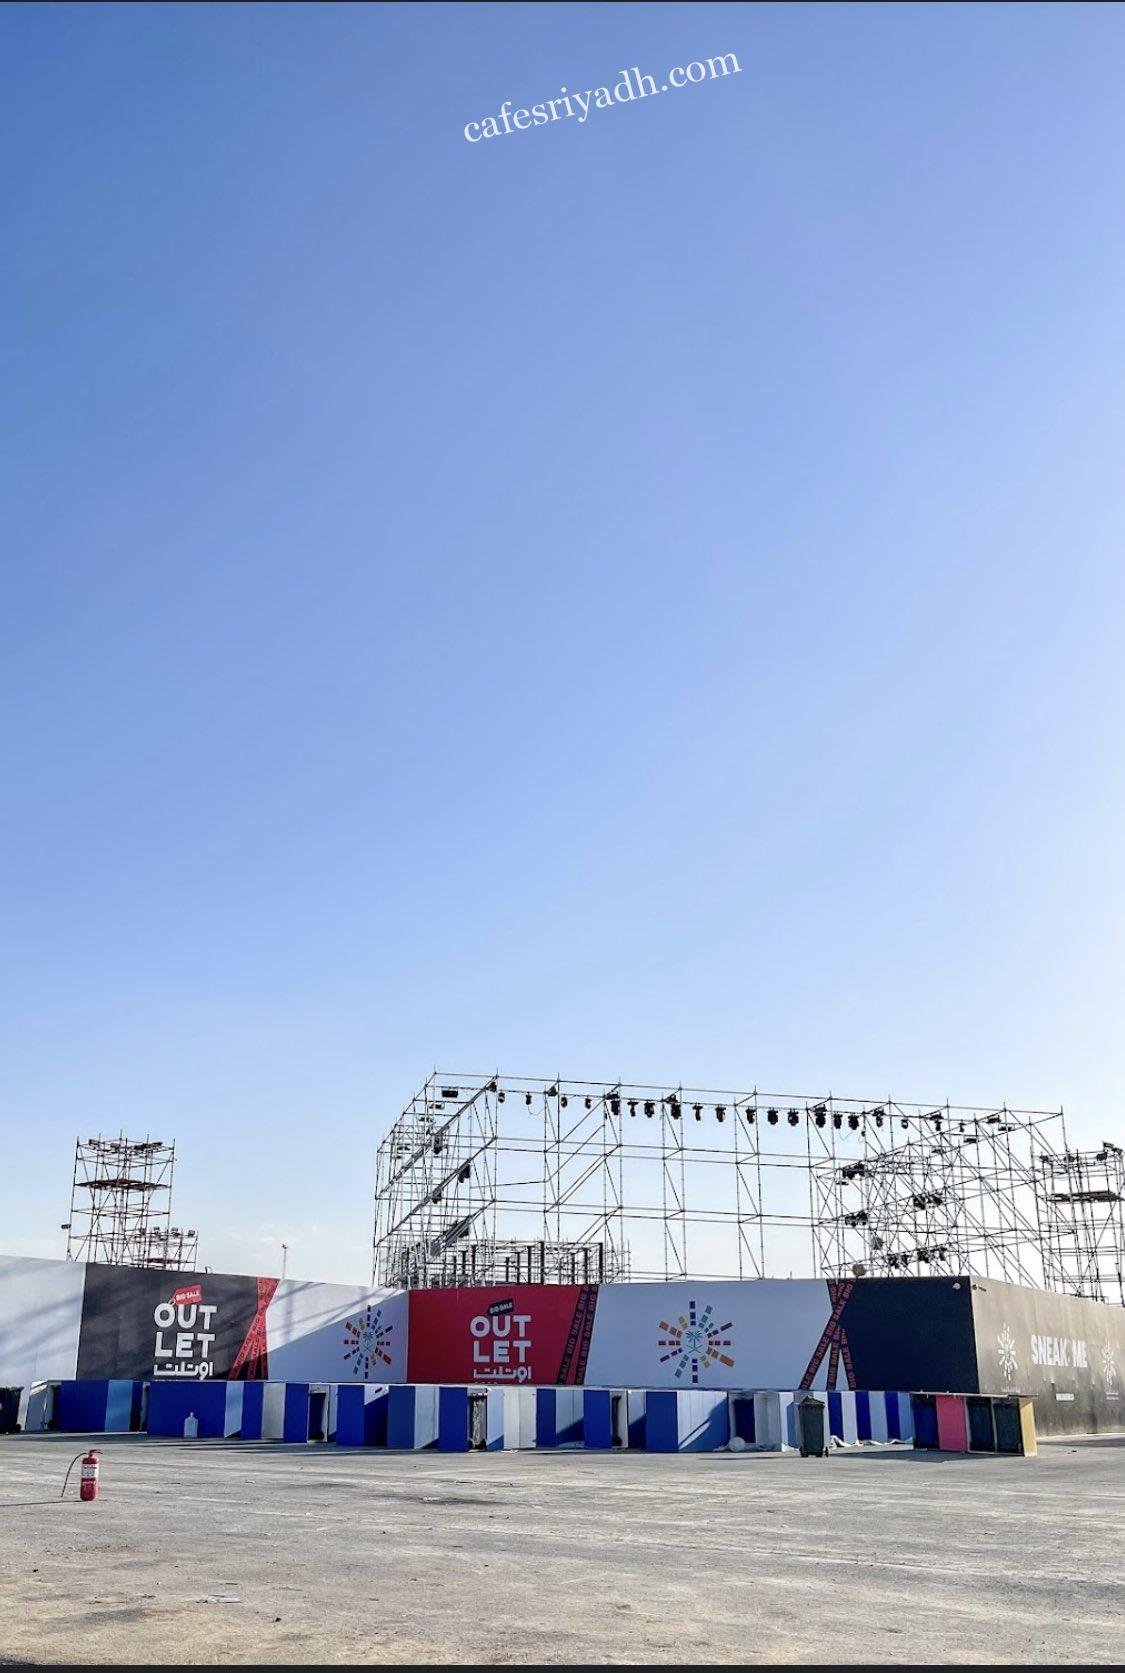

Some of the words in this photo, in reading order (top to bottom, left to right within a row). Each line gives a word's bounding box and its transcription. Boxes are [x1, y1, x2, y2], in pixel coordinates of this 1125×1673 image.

[187, 1290, 200, 1299] SALE
[154, 1302, 217, 1330] OUT
[470, 1315, 531, 1338] OUT
[155, 1332, 215, 1358] LET
[473, 1340, 531, 1363] LET
[1030, 1334, 1068, 1367] SNEAK
[1072, 1339, 1088, 1368] ME
[153, 1361, 213, 1381] اوتلت
[473, 1366, 532, 1383] اوتلت
